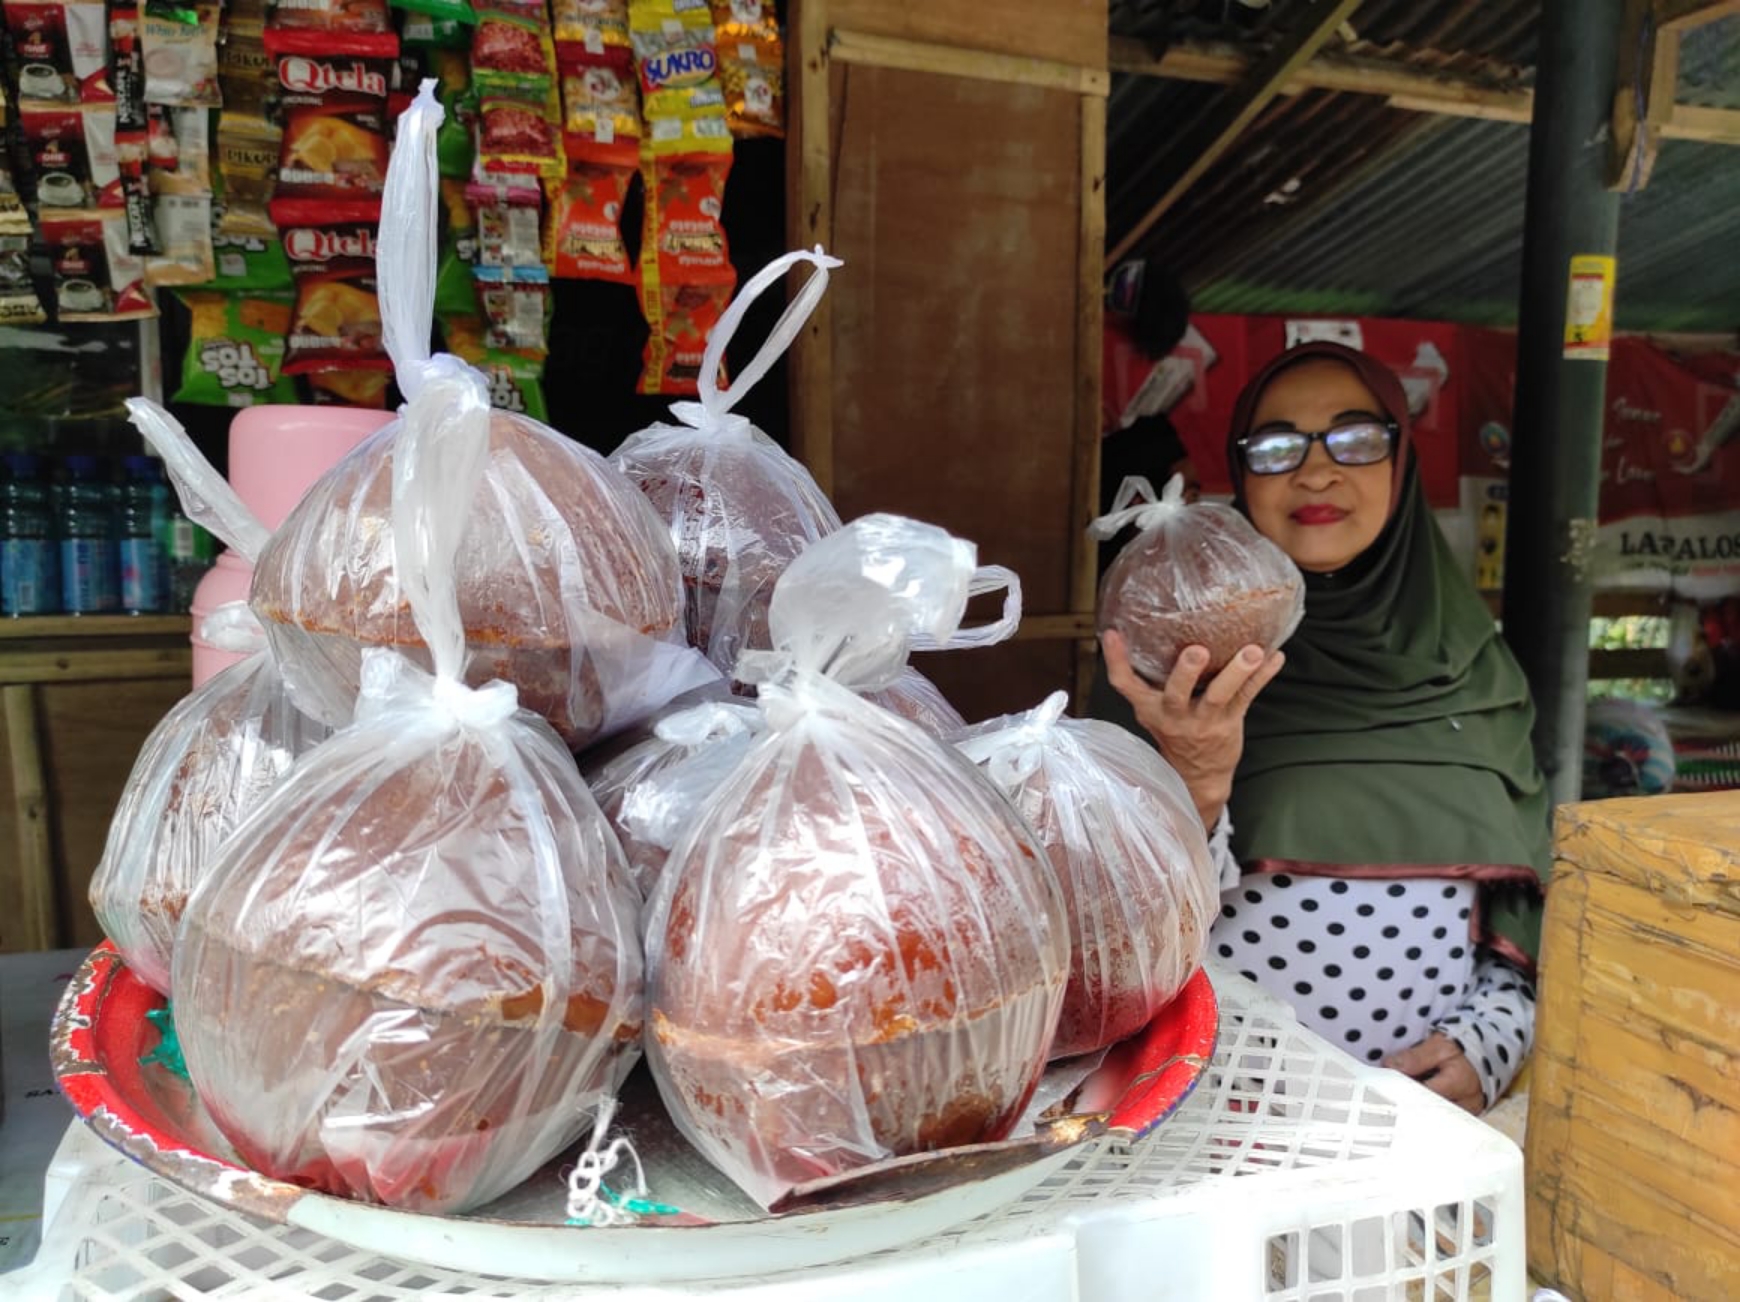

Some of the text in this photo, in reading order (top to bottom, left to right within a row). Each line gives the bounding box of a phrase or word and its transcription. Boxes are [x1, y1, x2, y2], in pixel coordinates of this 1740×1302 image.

[279, 57, 386, 97] Qtela
[645, 48, 716, 84] SUKRO
[286, 228, 378, 261] Qtel
